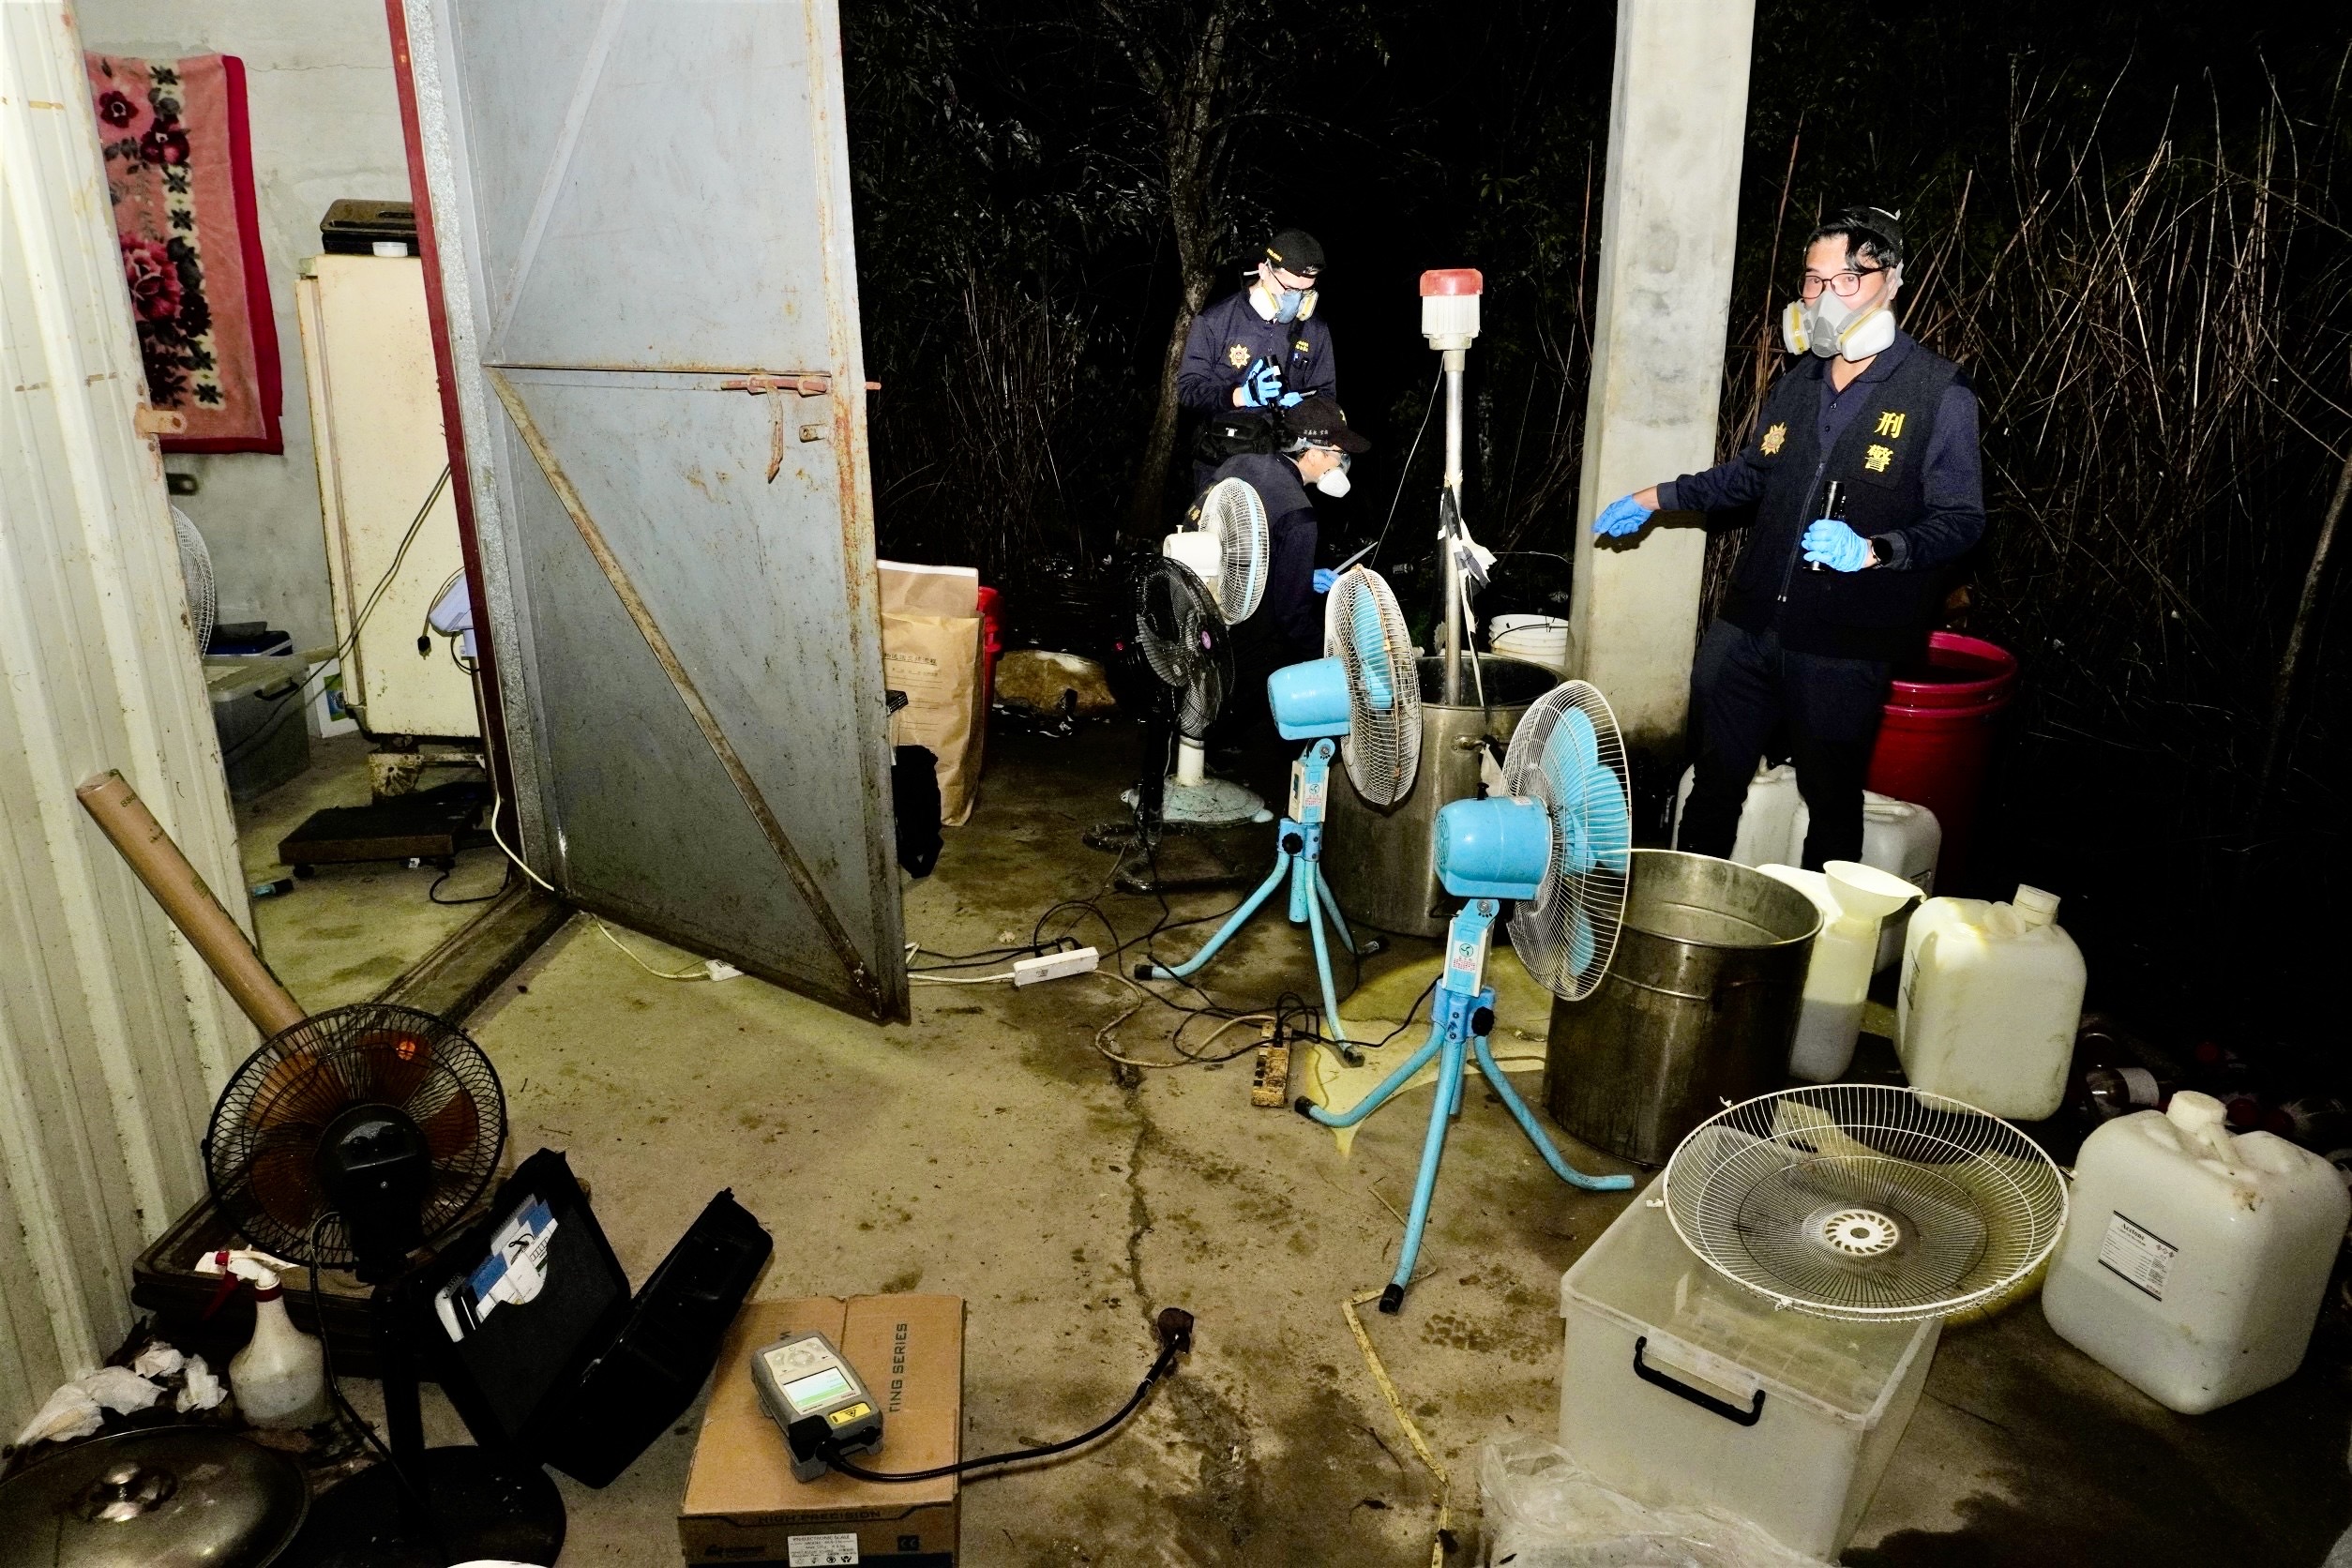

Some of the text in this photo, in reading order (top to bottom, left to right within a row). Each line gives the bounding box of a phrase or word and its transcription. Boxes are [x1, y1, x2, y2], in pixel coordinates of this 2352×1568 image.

[1865, 411, 1906, 472] 刑警
[2121, 1223, 2146, 1241] Acetone
[893, 1323, 908, 1373] SERIES
[758, 1511, 882, 1523] HIGH PRECISION
